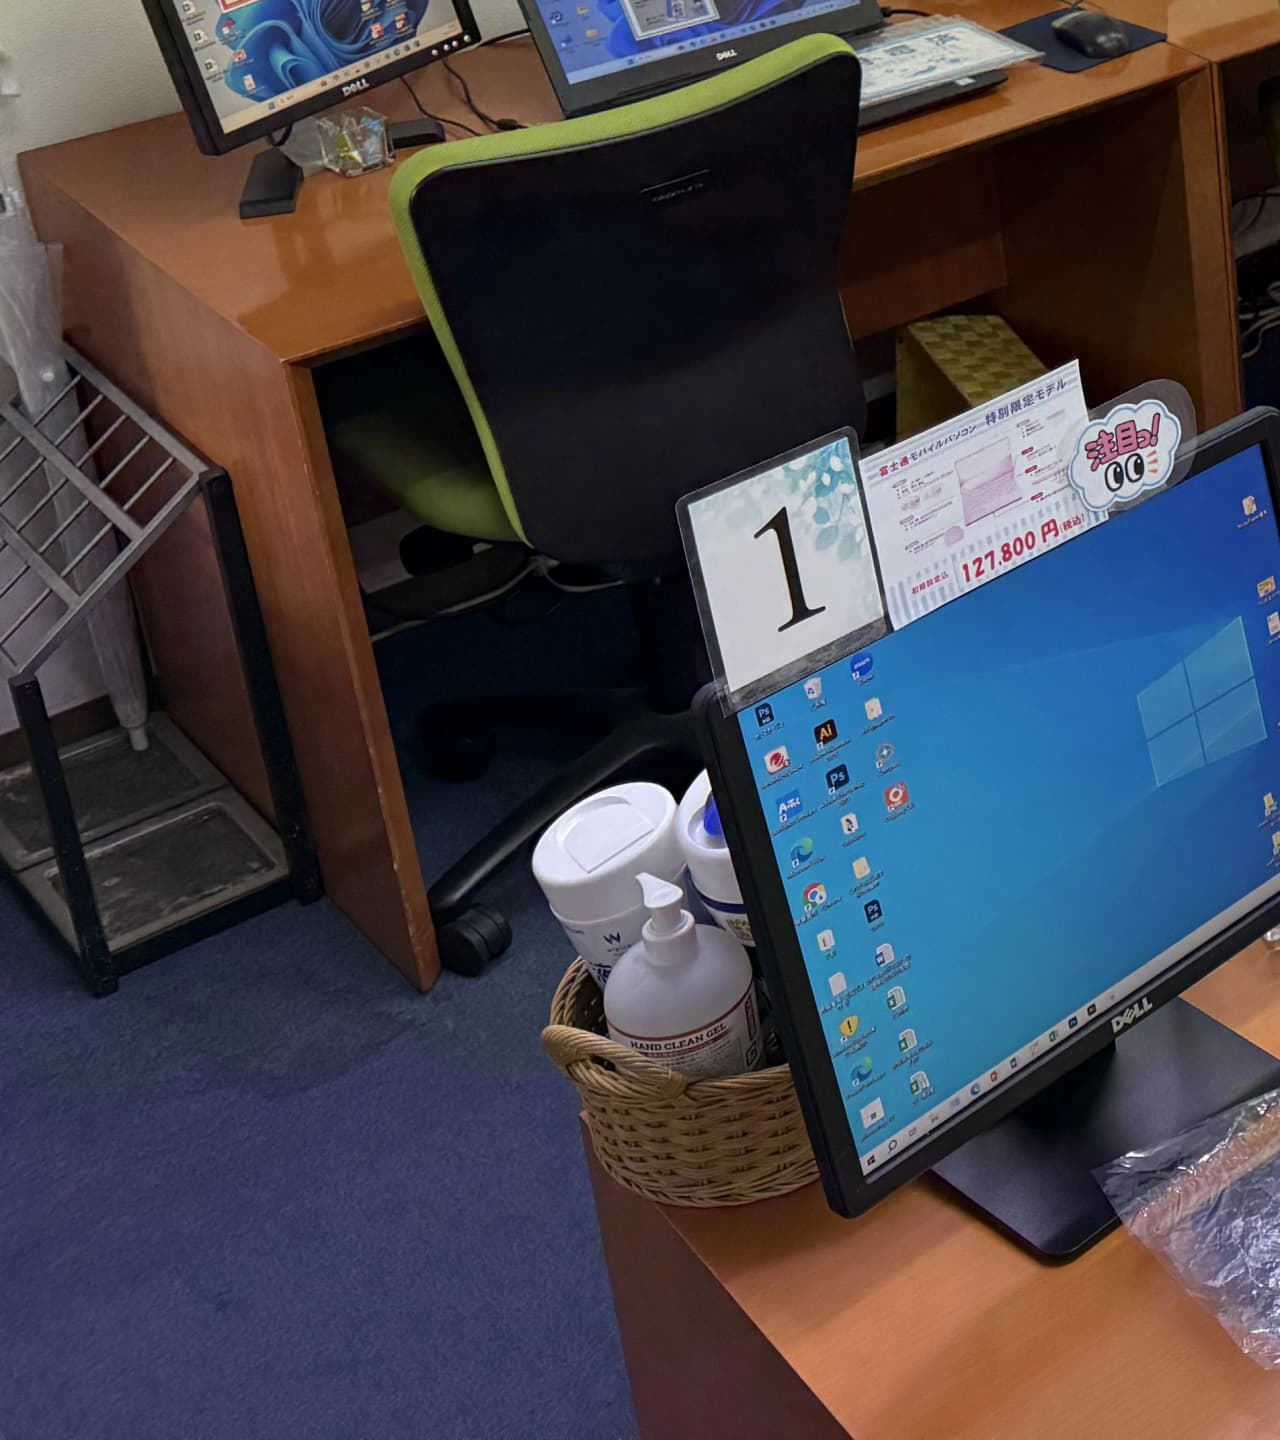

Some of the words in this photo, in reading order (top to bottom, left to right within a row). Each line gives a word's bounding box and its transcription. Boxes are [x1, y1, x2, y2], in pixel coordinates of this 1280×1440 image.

[716, 49, 738, 60] DELL
[341, 78, 370, 97] DELL
[879, 423, 978, 478] 富士通モバイルパソコン
[984, 378, 1069, 427] 特別限定モデル
[754, 506, 826, 633] 1
[819, 723, 832, 740] Ai
[830, 770, 846, 784] Ps
[1111, 996, 1153, 1033] DELL
[630, 1038, 662, 1052] HAND
[664, 1033, 704, 1051] CLEAN
[706, 1023, 727, 1041] GEL
